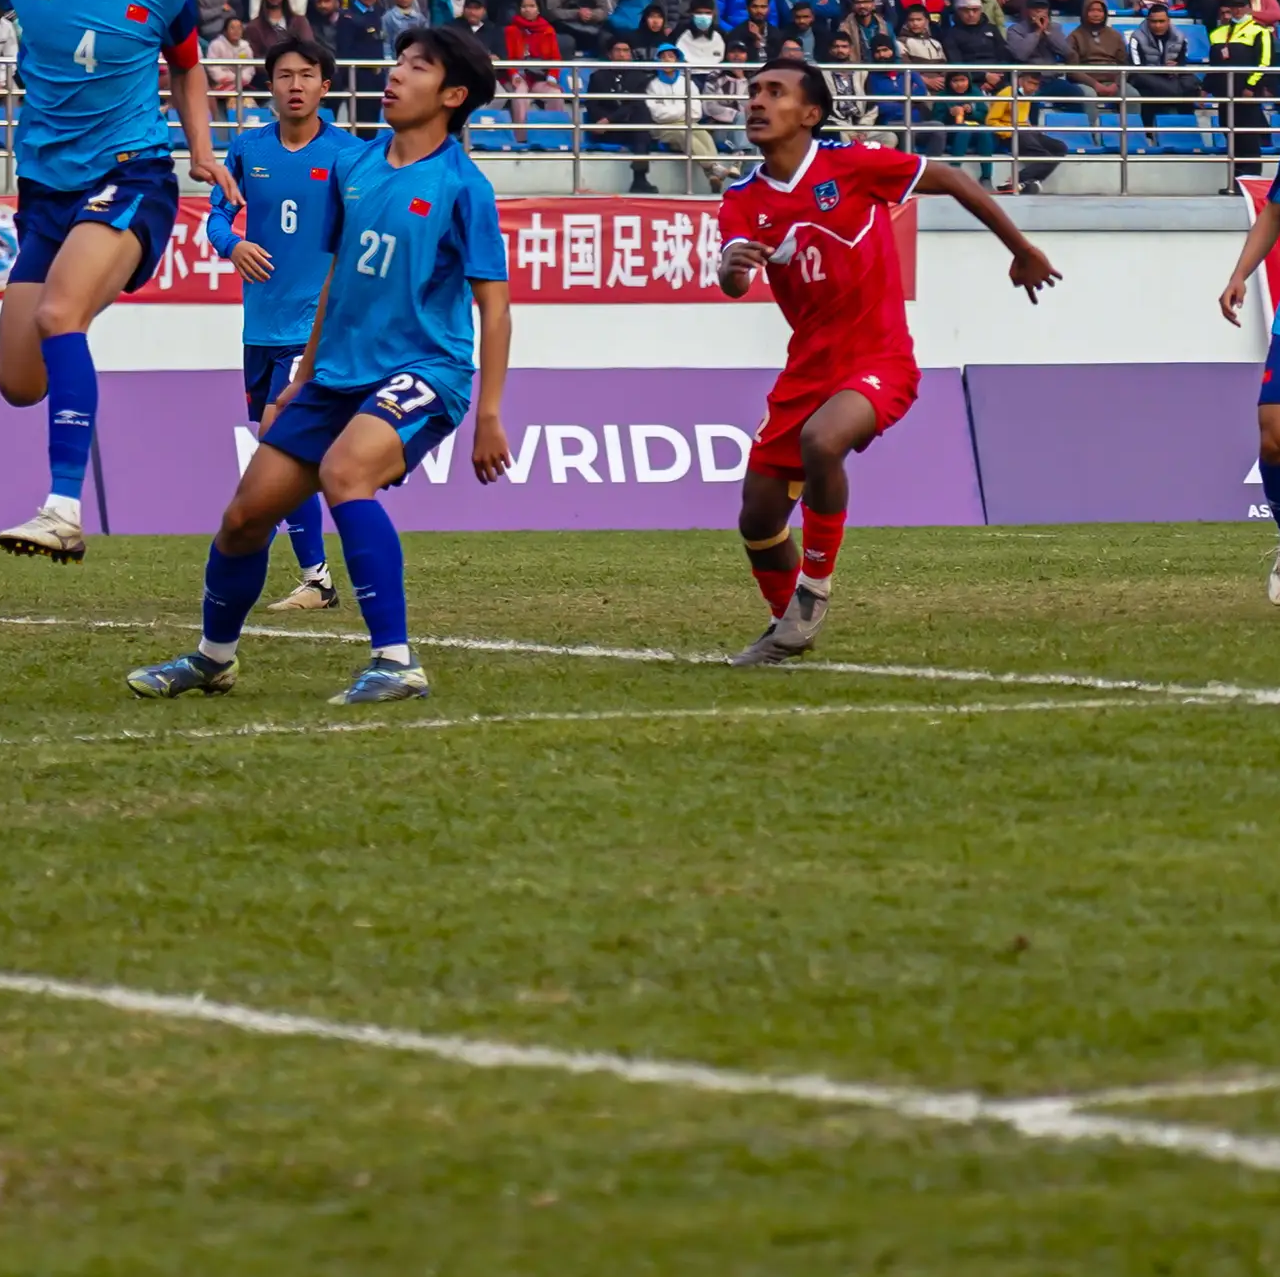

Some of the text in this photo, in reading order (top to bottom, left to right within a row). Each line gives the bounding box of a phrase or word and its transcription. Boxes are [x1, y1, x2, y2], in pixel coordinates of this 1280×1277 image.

[74, 29, 98, 74] 4
[280, 199, 298, 234] 6
[357, 229, 397, 279] 27
[795, 245, 827, 284] 12
[376, 373, 437, 413] 27
